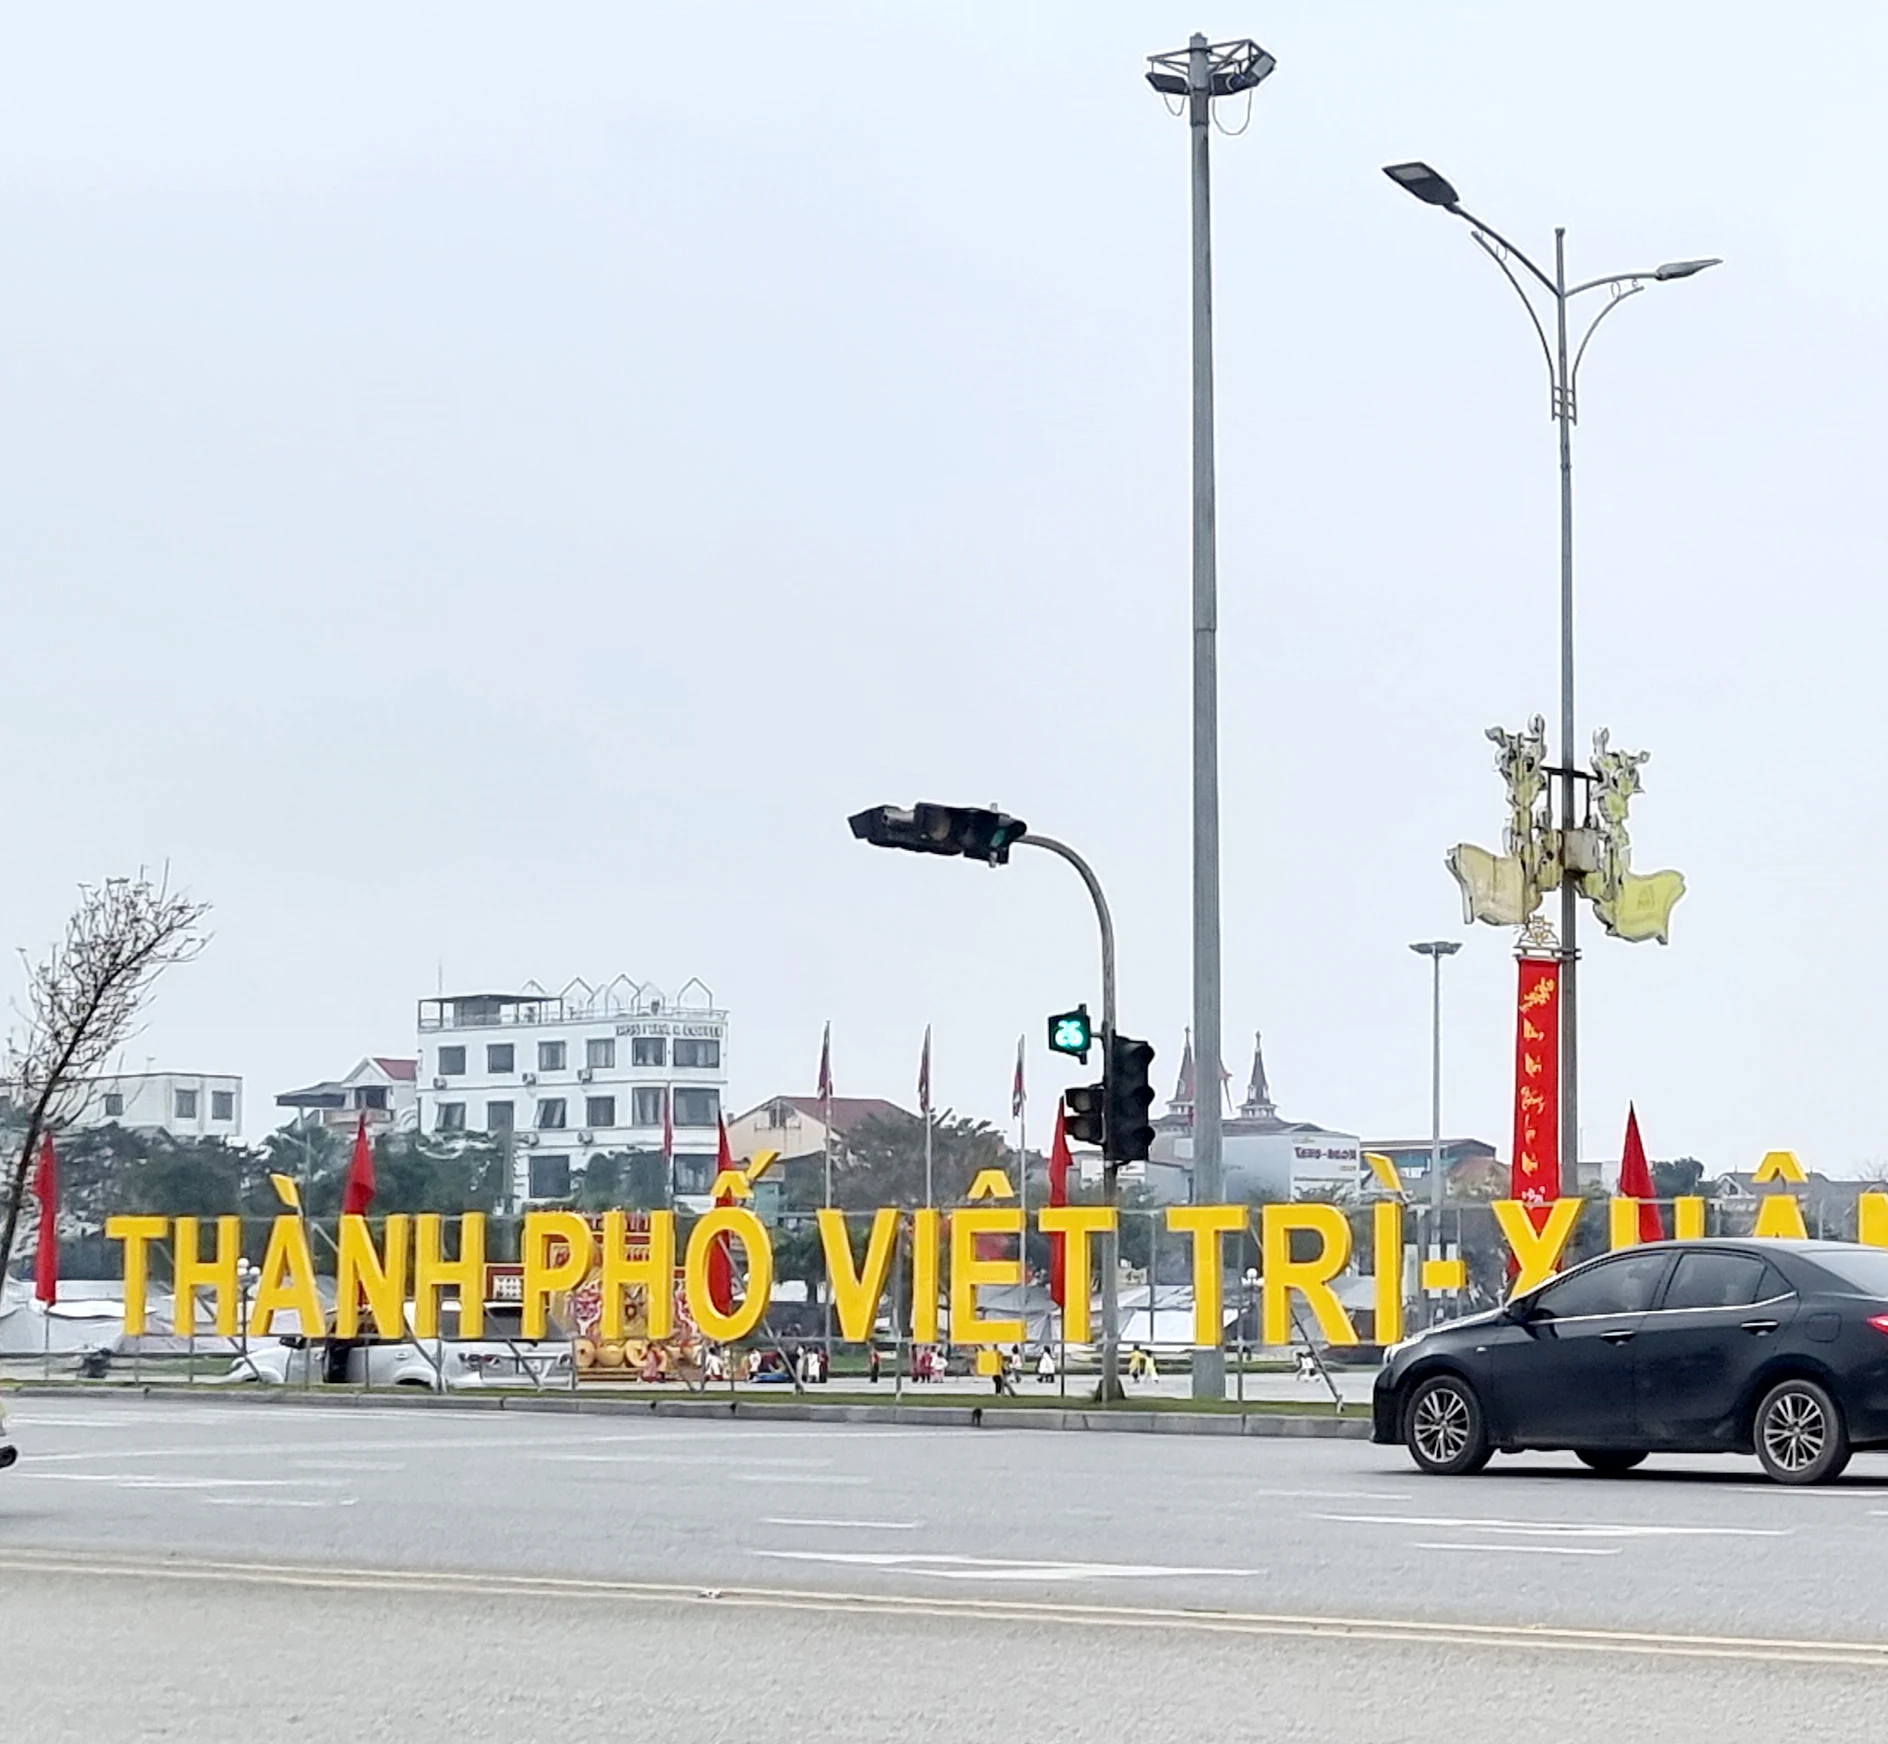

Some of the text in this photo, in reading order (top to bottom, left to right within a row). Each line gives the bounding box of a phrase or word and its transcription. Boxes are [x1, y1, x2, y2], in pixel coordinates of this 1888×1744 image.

[105, 1173, 486, 1340] THÀNH
[521, 1149, 779, 1343] PHỐ
[817, 1169, 1119, 1377] VIỆT
